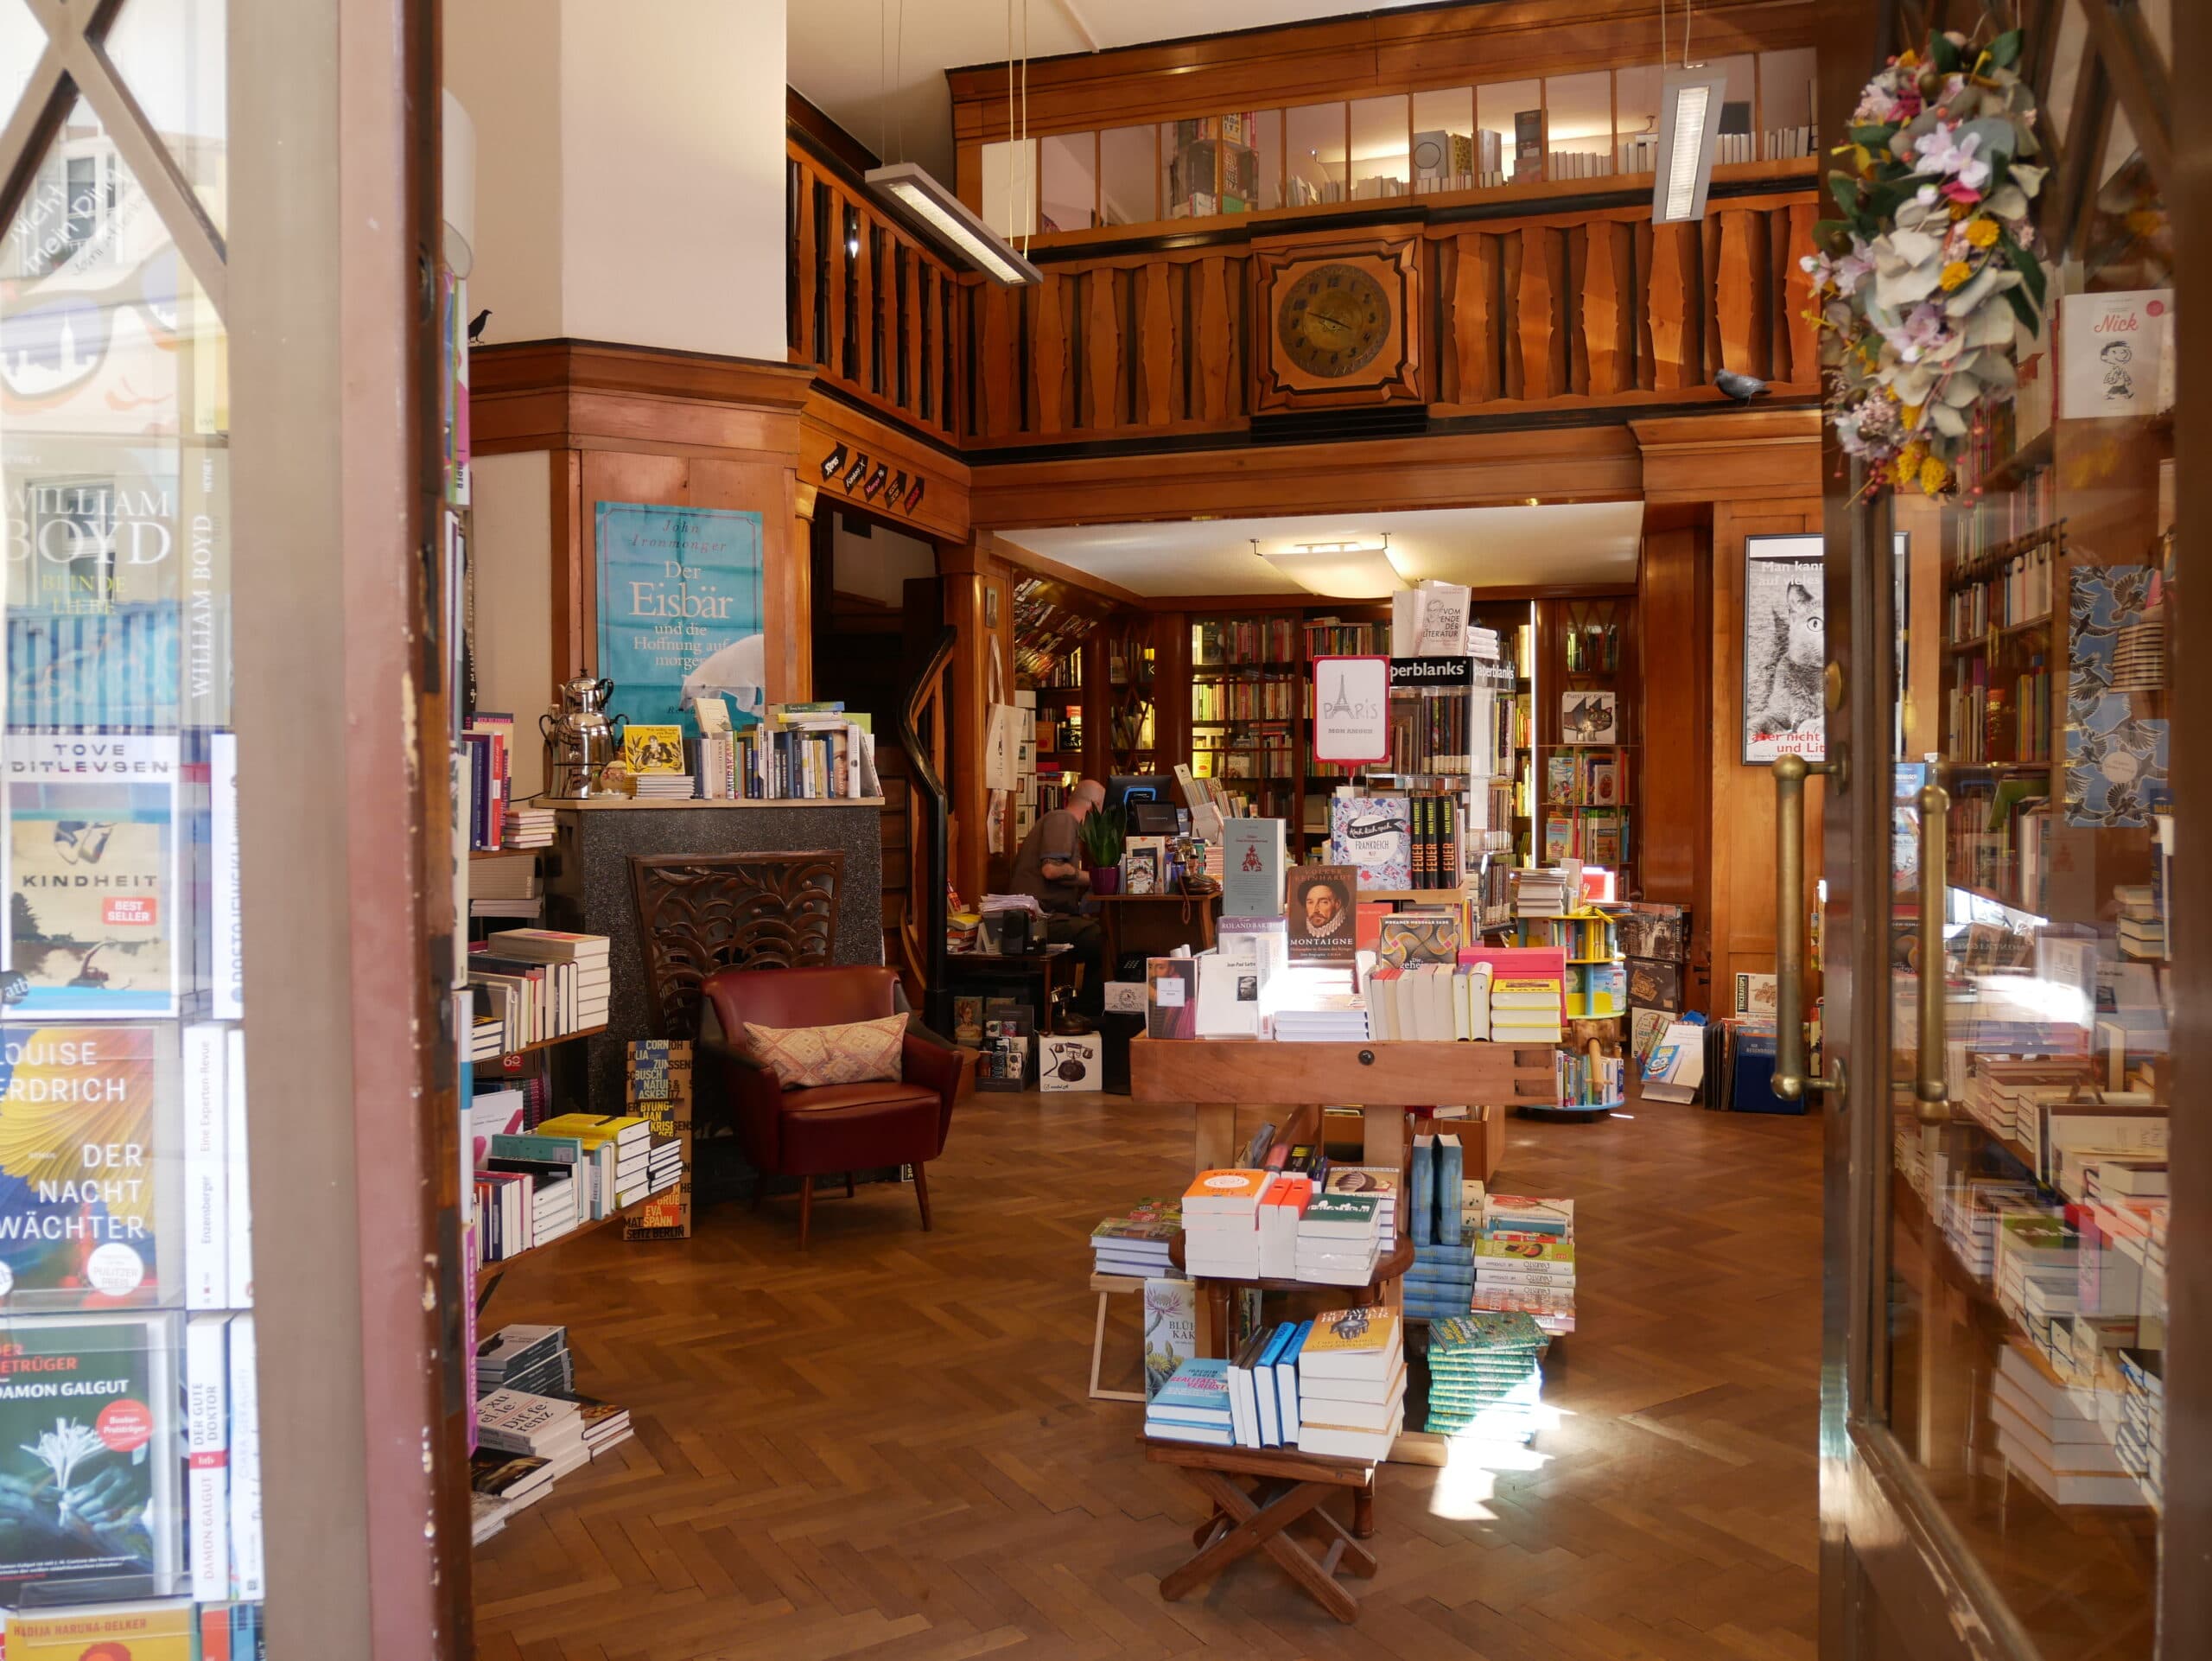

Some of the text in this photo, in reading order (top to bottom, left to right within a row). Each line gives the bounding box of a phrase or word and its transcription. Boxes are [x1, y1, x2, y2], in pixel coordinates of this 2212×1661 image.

[2094, 312, 2139, 333] Nick
[4, 487, 172, 517] WILLIAM
[663, 519, 700, 533] John
[3, 519, 172, 565] BOYD
[631, 534, 728, 554] Ironmonger
[664, 561, 702, 580] Der
[1761, 562, 1790, 573] Man
[1758, 574, 1820, 587] auf vieles
[192, 515, 212, 699] WILLIAM BOYD
[628, 581, 734, 620] Eisbär
[655, 622, 708, 636] und die
[1422, 630, 1459, 639] LITERATUR
[633, 636, 702, 655] Hoffnung
[1390, 660, 1465, 683] perblanks
[1473, 665, 1515, 681] paperblanks
[1751, 731, 1821, 742] aber nicht
[54, 743, 126, 756] TOVE
[1777, 742, 1825, 754] und Lit
[11, 760, 169, 774] DITLEVSEN
[726, 740, 735, 792] MURAKAMI
[1355, 840, 1389, 850] FRANKREICH
[1412, 843, 1424, 872] FEUER
[1426, 843, 1437, 872] FEUER
[1443, 843, 1455, 871] FEUER
[22, 875, 158, 888] KINDHEIT
[114, 901, 145, 912] BEST
[107, 912, 150, 923] SELLER
[1222, 921, 1251, 930] ROLAND
[1290, 938, 1354, 946] MONTAIGNE
[1400, 960, 1422, 970] gehe
[1738, 977, 1746, 1010] TRICERATOPS
[0, 1042, 98, 1066] OUISE
[643, 1079, 669, 1090] NATU
[639, 1090, 669, 1099] ASKES
[200, 1130, 211, 1153] Eine
[83, 1144, 143, 1168] DER
[39, 1180, 143, 1204] NACHT
[201, 1175, 214, 1244] Enzensberger
[645, 1206, 662, 1216] EVA
[0, 1212, 145, 1239] WÄCHTER
[0, 1344, 24, 1357] ER
[0, 1357, 79, 1374] ETRÜGER
[0, 1379, 130, 1400] AMON GALGUT
[193, 1382, 204, 1446] DER GUTE
[206, 1384, 218, 1441] DOKTOR
[201, 1476, 215, 1581] DAMON GALGUT
